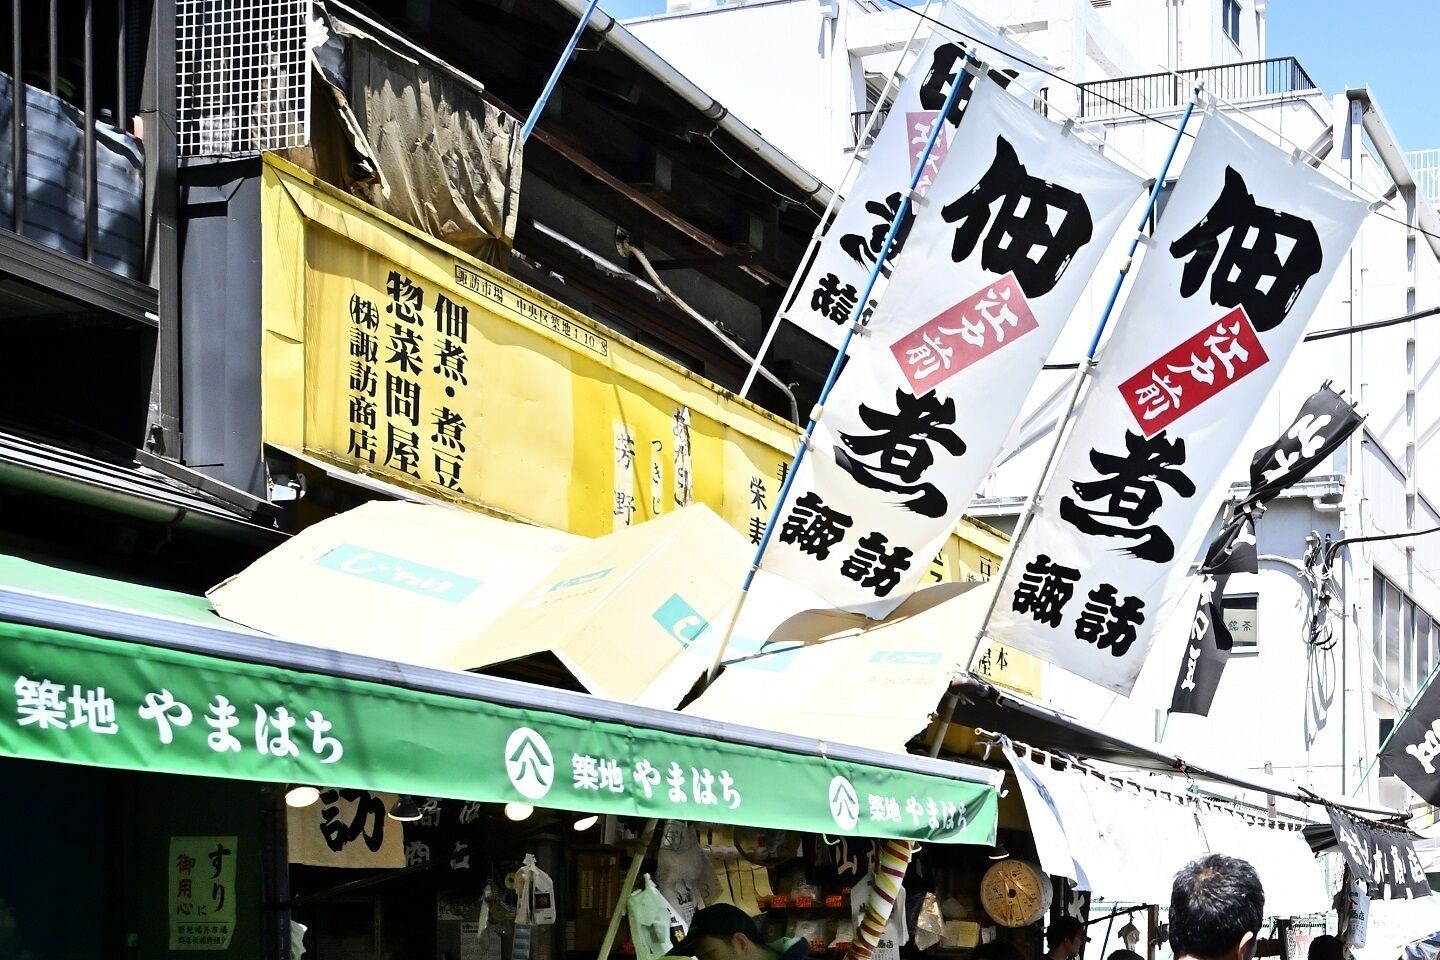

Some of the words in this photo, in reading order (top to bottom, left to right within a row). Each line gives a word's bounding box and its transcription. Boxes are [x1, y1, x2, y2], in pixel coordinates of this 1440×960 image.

[941, 134, 1094, 299] 佃
[1170, 165, 1323, 332] 佃
[457, 266, 504, 304] 諏訪市場
[905, 284, 1021, 382] 江戸前
[383, 270, 424, 480] 惣菜問屋
[430, 292, 470, 494] 佃煮・煮豆
[1132, 319, 1251, 421] 江戸前
[613, 433, 636, 526] 芳野
[651, 440, 663, 515] つきじ
[834, 387, 967, 518] 煮
[1060, 429, 1197, 564] 煮
[779, 491, 914, 597] 諏訪
[1012, 554, 1146, 658] 諏訪
[14, 675, 119, 735] 築地
[138, 688, 344, 764] やまはち
[571, 753, 625, 793] 築地
[633, 759, 742, 809] やまはち
[868, 794, 902, 823] 築地
[905, 795, 967, 833] やまはち
[176, 853, 196, 915] 御用心
[197, 905, 208, 915] に
[208, 843, 232, 912] すり
